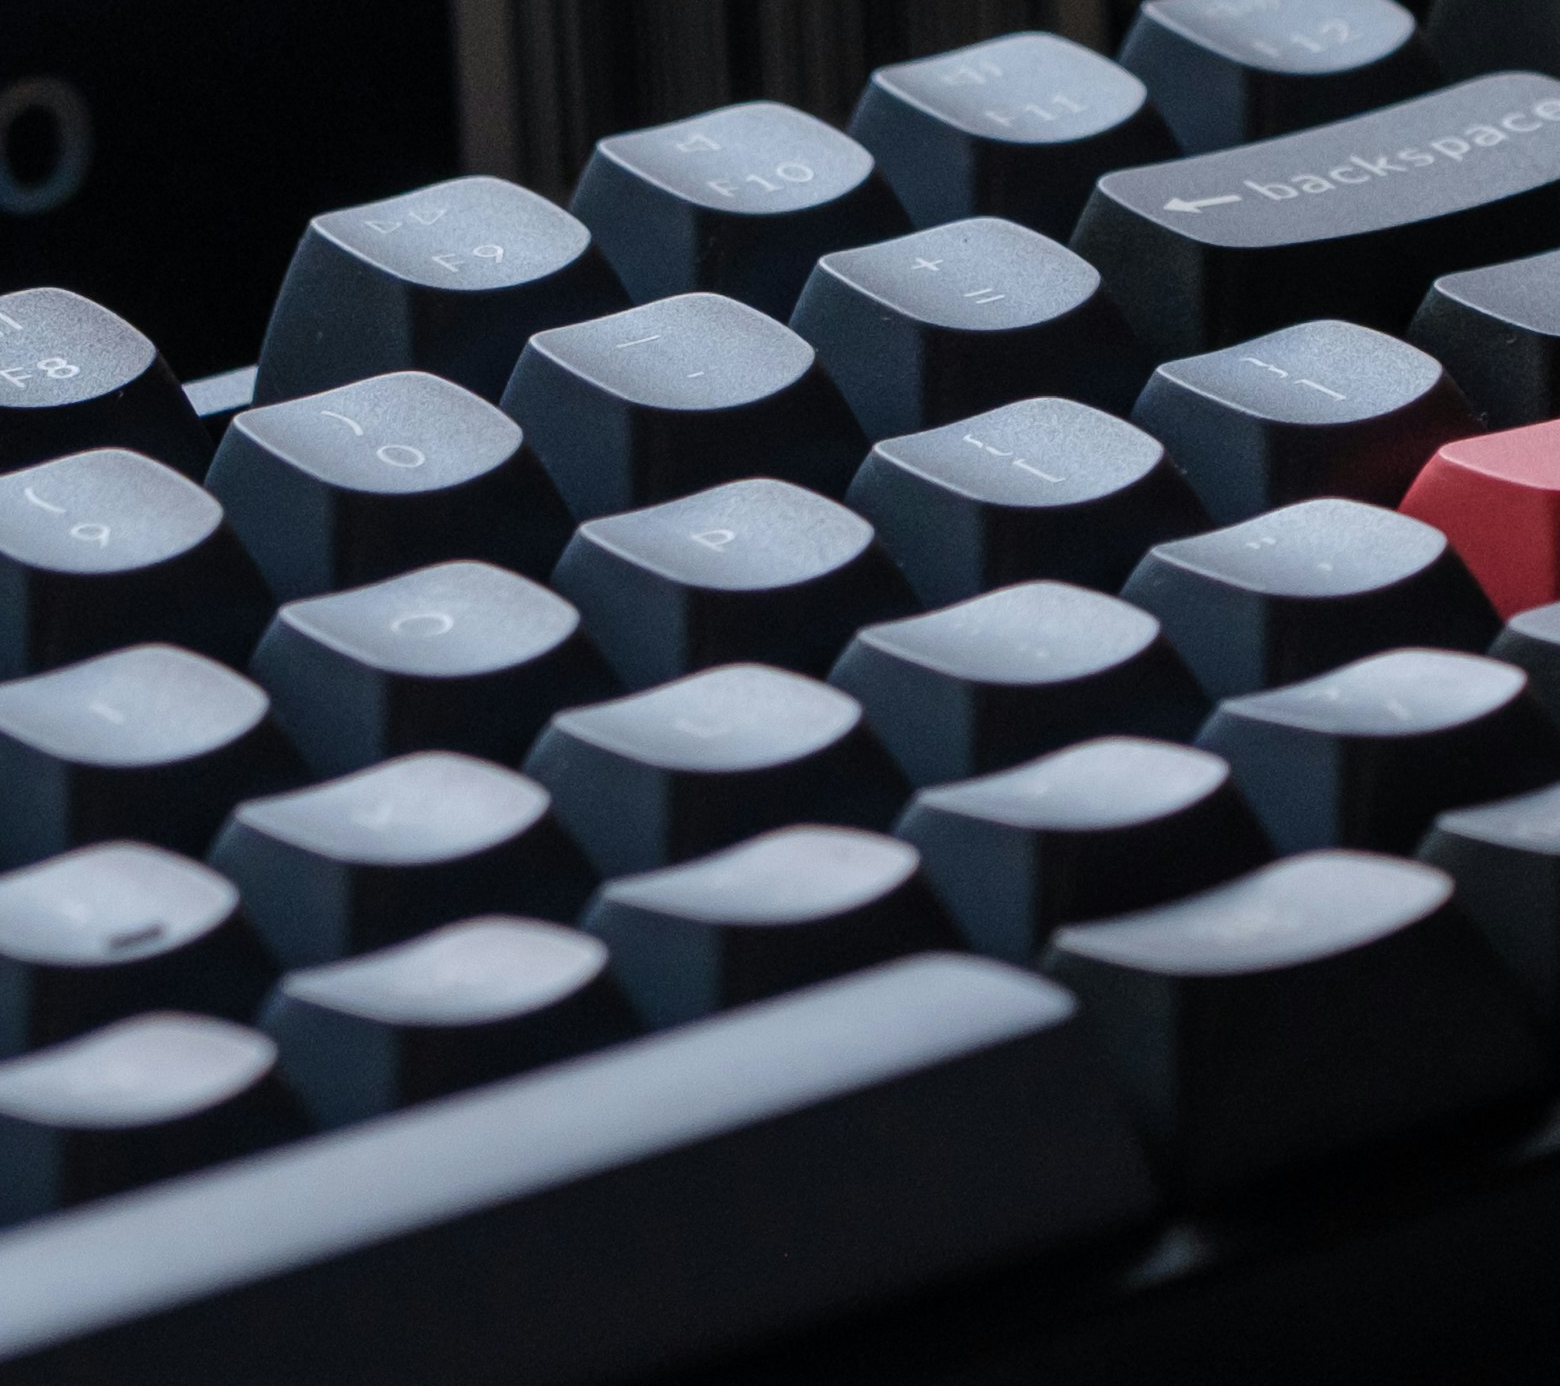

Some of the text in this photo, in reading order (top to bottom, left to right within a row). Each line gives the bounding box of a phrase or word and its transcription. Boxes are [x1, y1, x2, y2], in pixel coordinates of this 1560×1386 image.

[706, 163, 814, 198] F10
[430, 243, 506, 274] F9
[69, 521, 112, 549] 9
